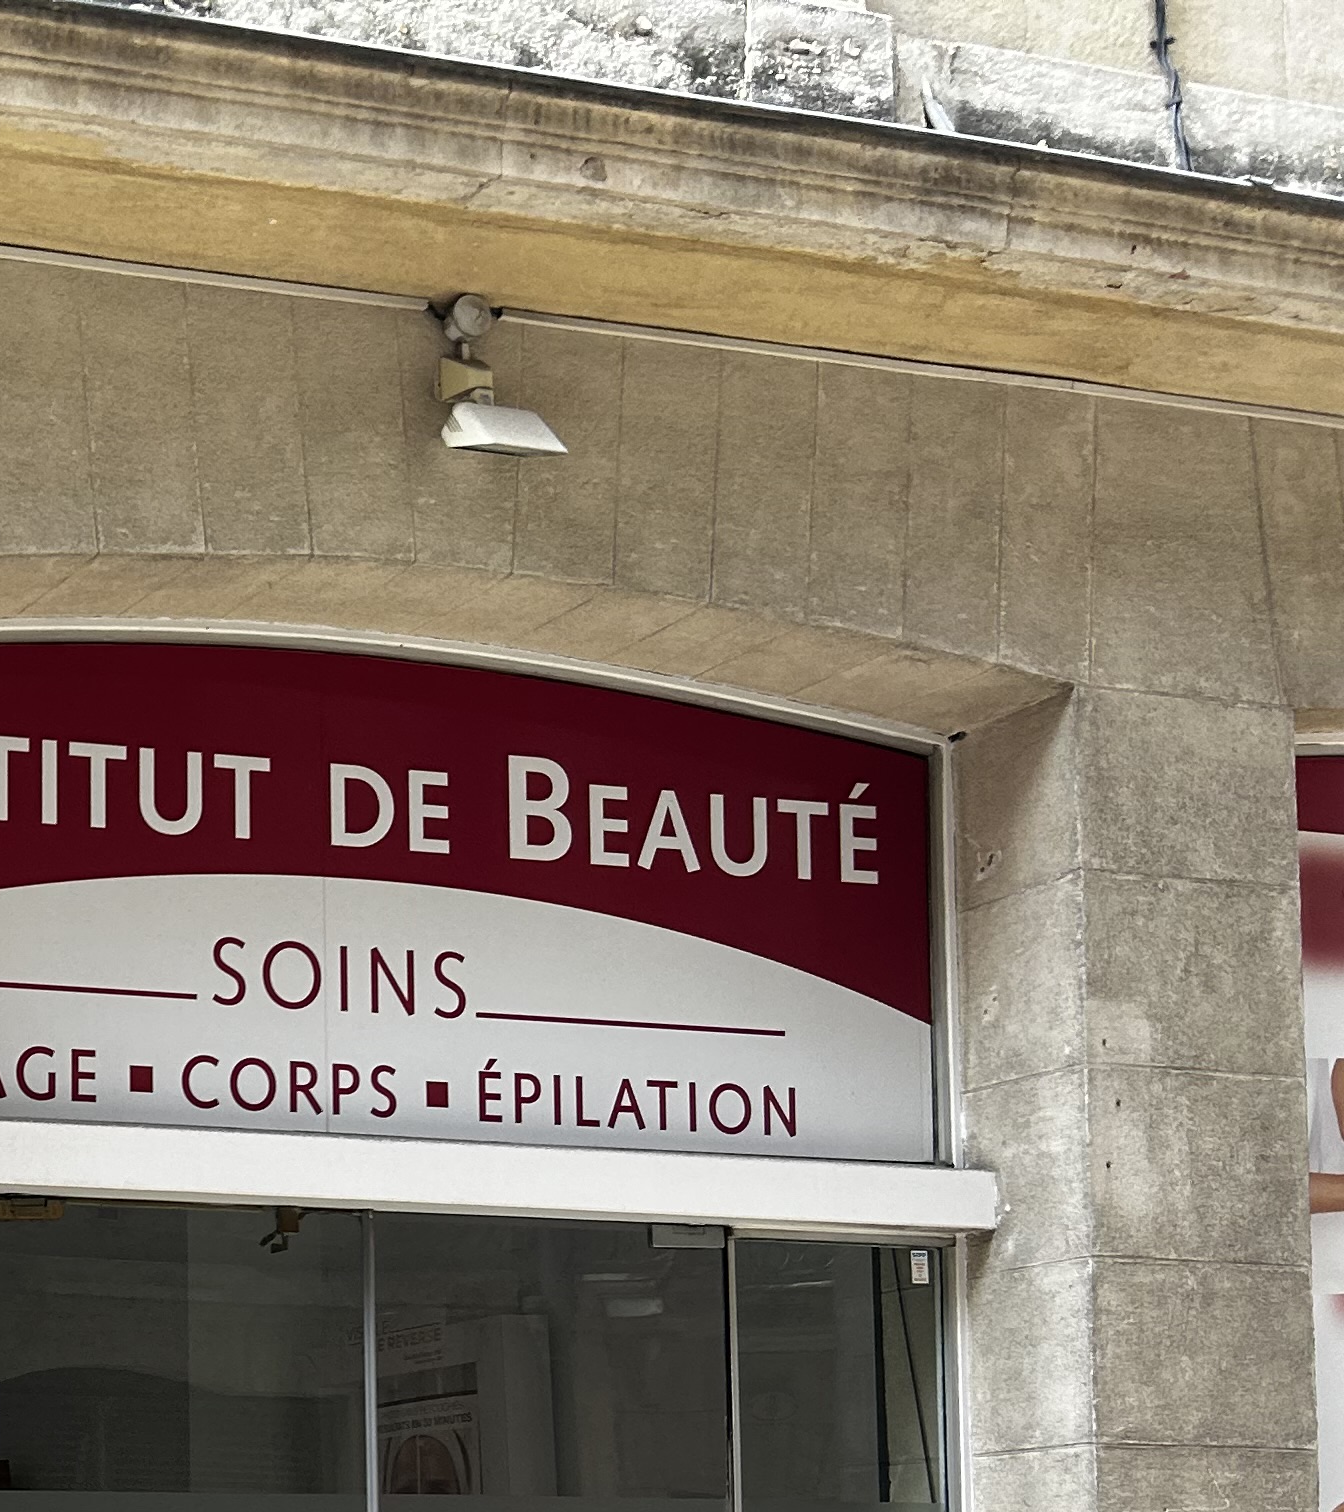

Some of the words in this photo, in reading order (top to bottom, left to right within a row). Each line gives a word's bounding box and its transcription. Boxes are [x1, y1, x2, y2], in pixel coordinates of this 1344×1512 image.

[330, 762, 450, 856] DE
[509, 754, 880, 885] BEAUTÉ
[211, 935, 470, 1020] SOINS
[180, 1054, 398, 1121] CORPS
[477, 1058, 799, 1138] ÉPILATION
